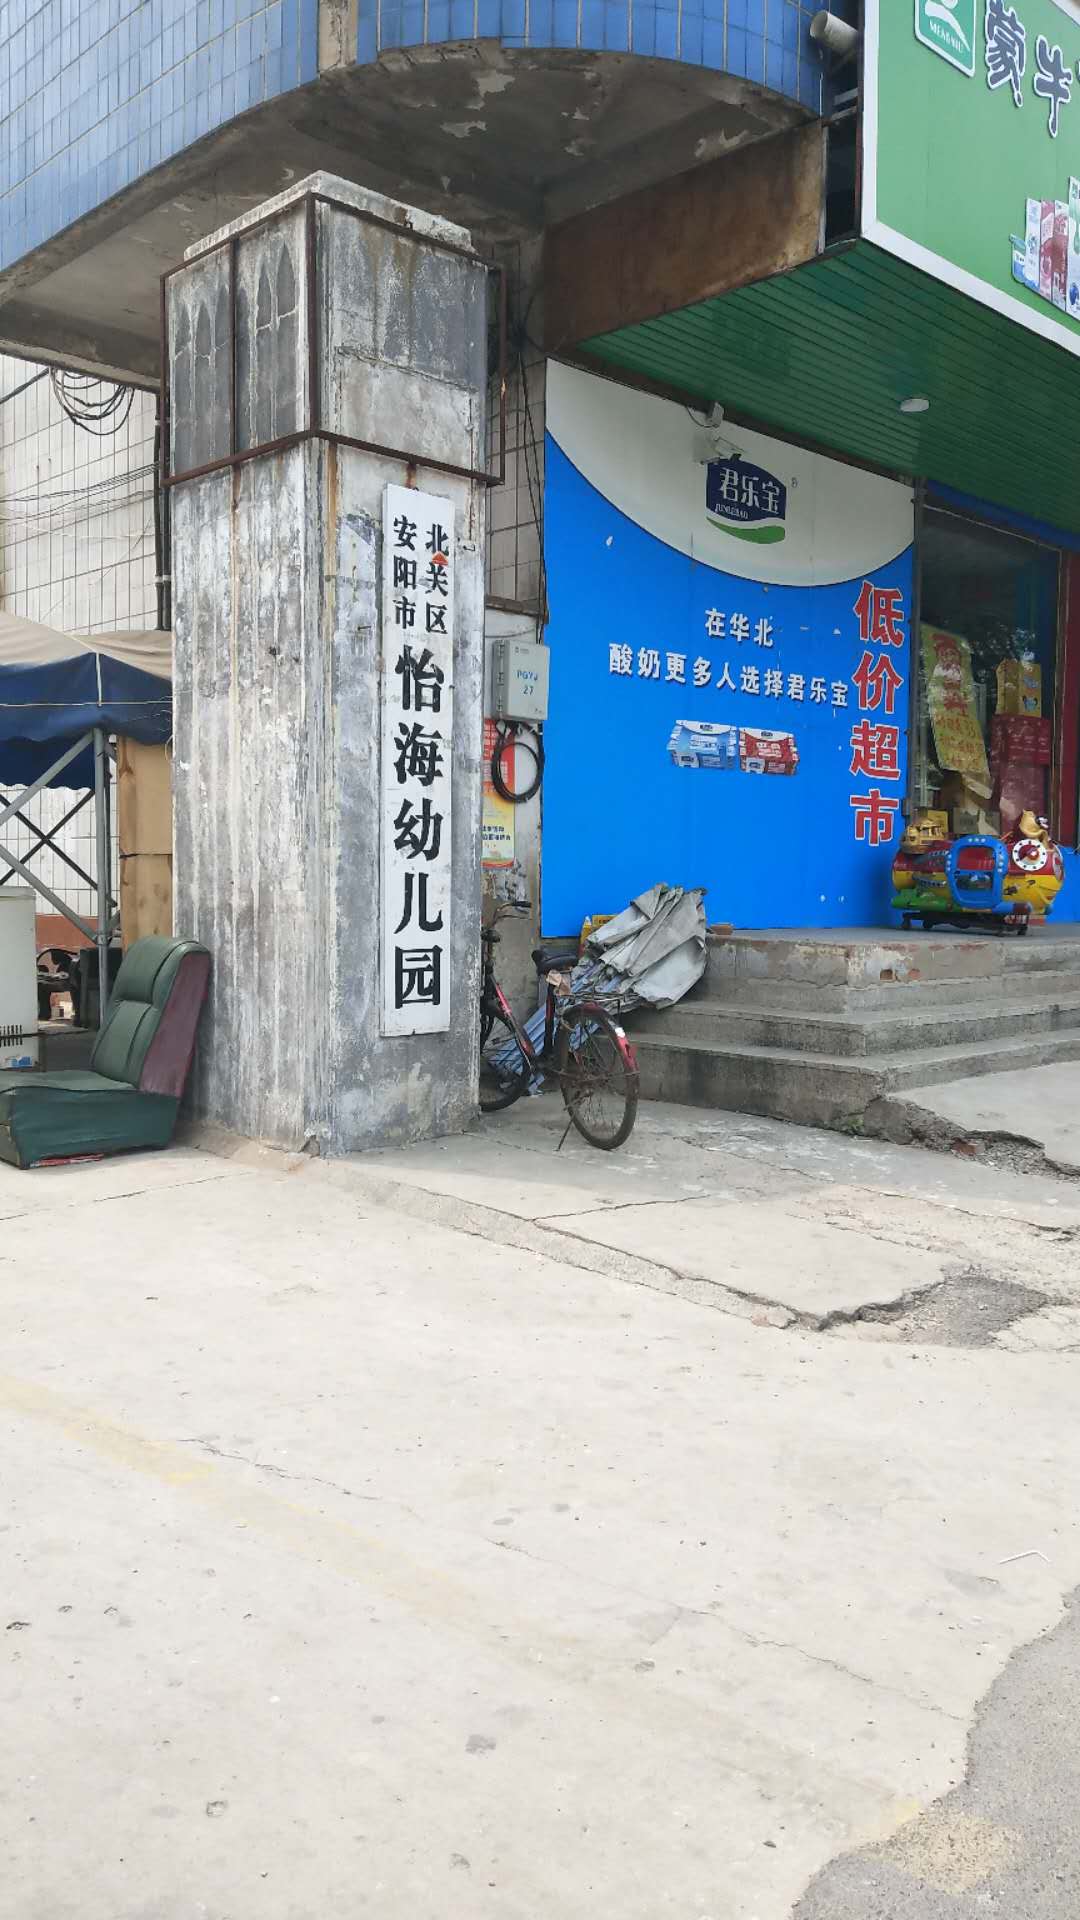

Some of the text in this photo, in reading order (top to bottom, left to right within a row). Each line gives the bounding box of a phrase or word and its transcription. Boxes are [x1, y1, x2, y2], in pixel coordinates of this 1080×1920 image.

[985, 0, 1073, 138] 蒙牛
[719, 467, 780, 515] 君乐宝
[393, 515, 417, 630] 安阳市
[425, 523, 449, 635] 北关区
[705, 607, 774, 648] 在华北
[608, 642, 849, 708] 酸奶更多人选择君乐宝
[849, 580, 904, 847] 低价超市
[393, 644, 445, 1009] 怡海幼儿园
